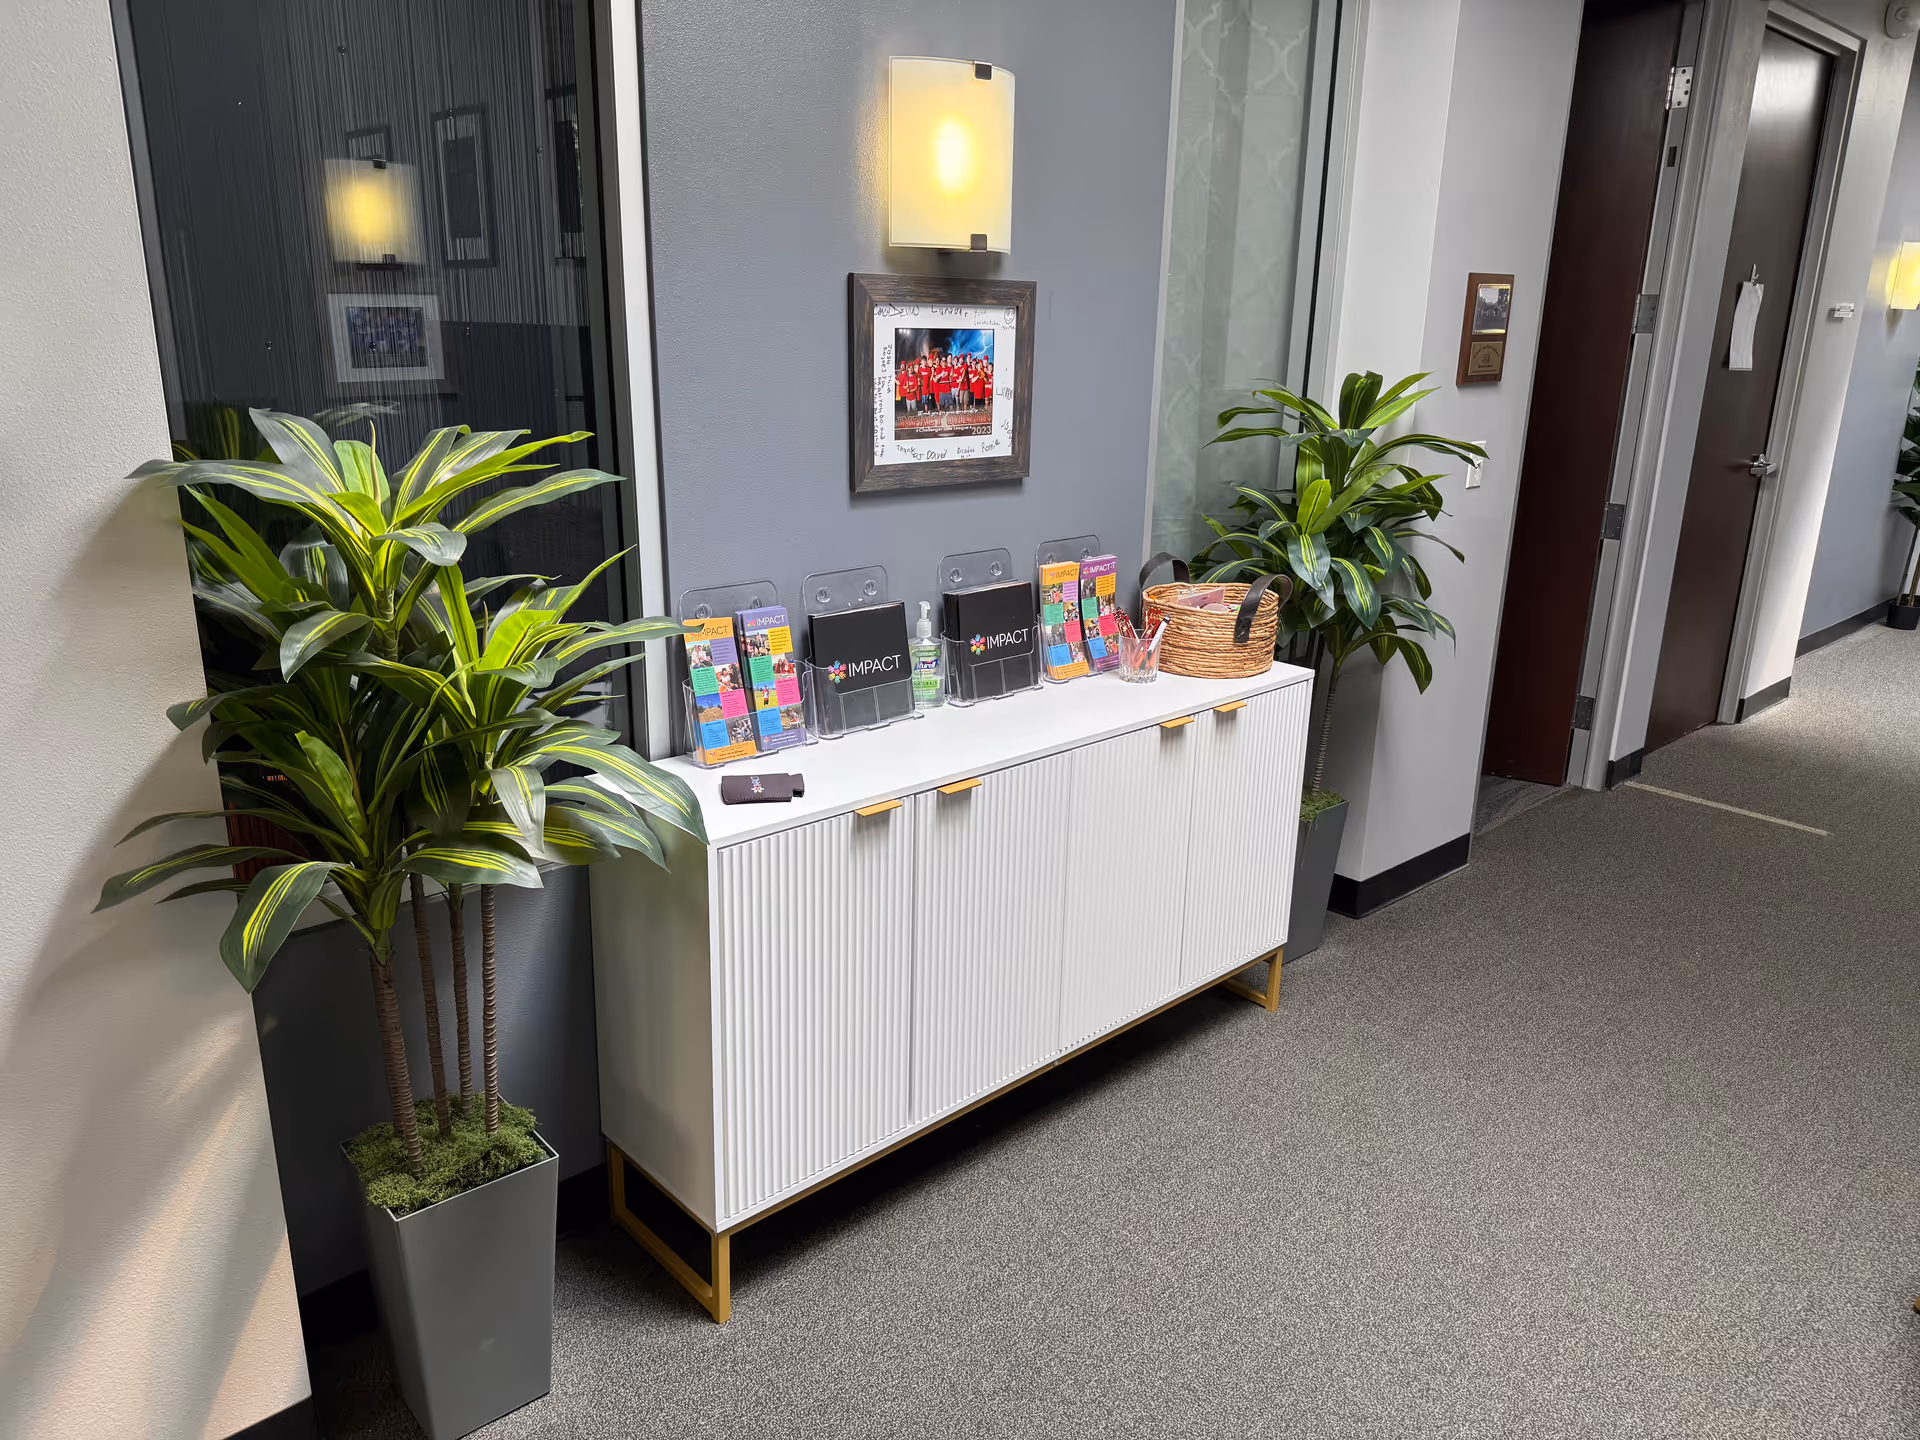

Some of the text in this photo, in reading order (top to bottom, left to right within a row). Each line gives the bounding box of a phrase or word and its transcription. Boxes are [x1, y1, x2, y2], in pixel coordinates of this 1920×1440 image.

[971, 425, 992, 435] 2023
[1056, 568, 1078, 578] IMPACT
[755, 614, 785, 626] IMPACT
[986, 628, 1028, 649] IMPACT
[848, 654, 901, 677] IMPACT
